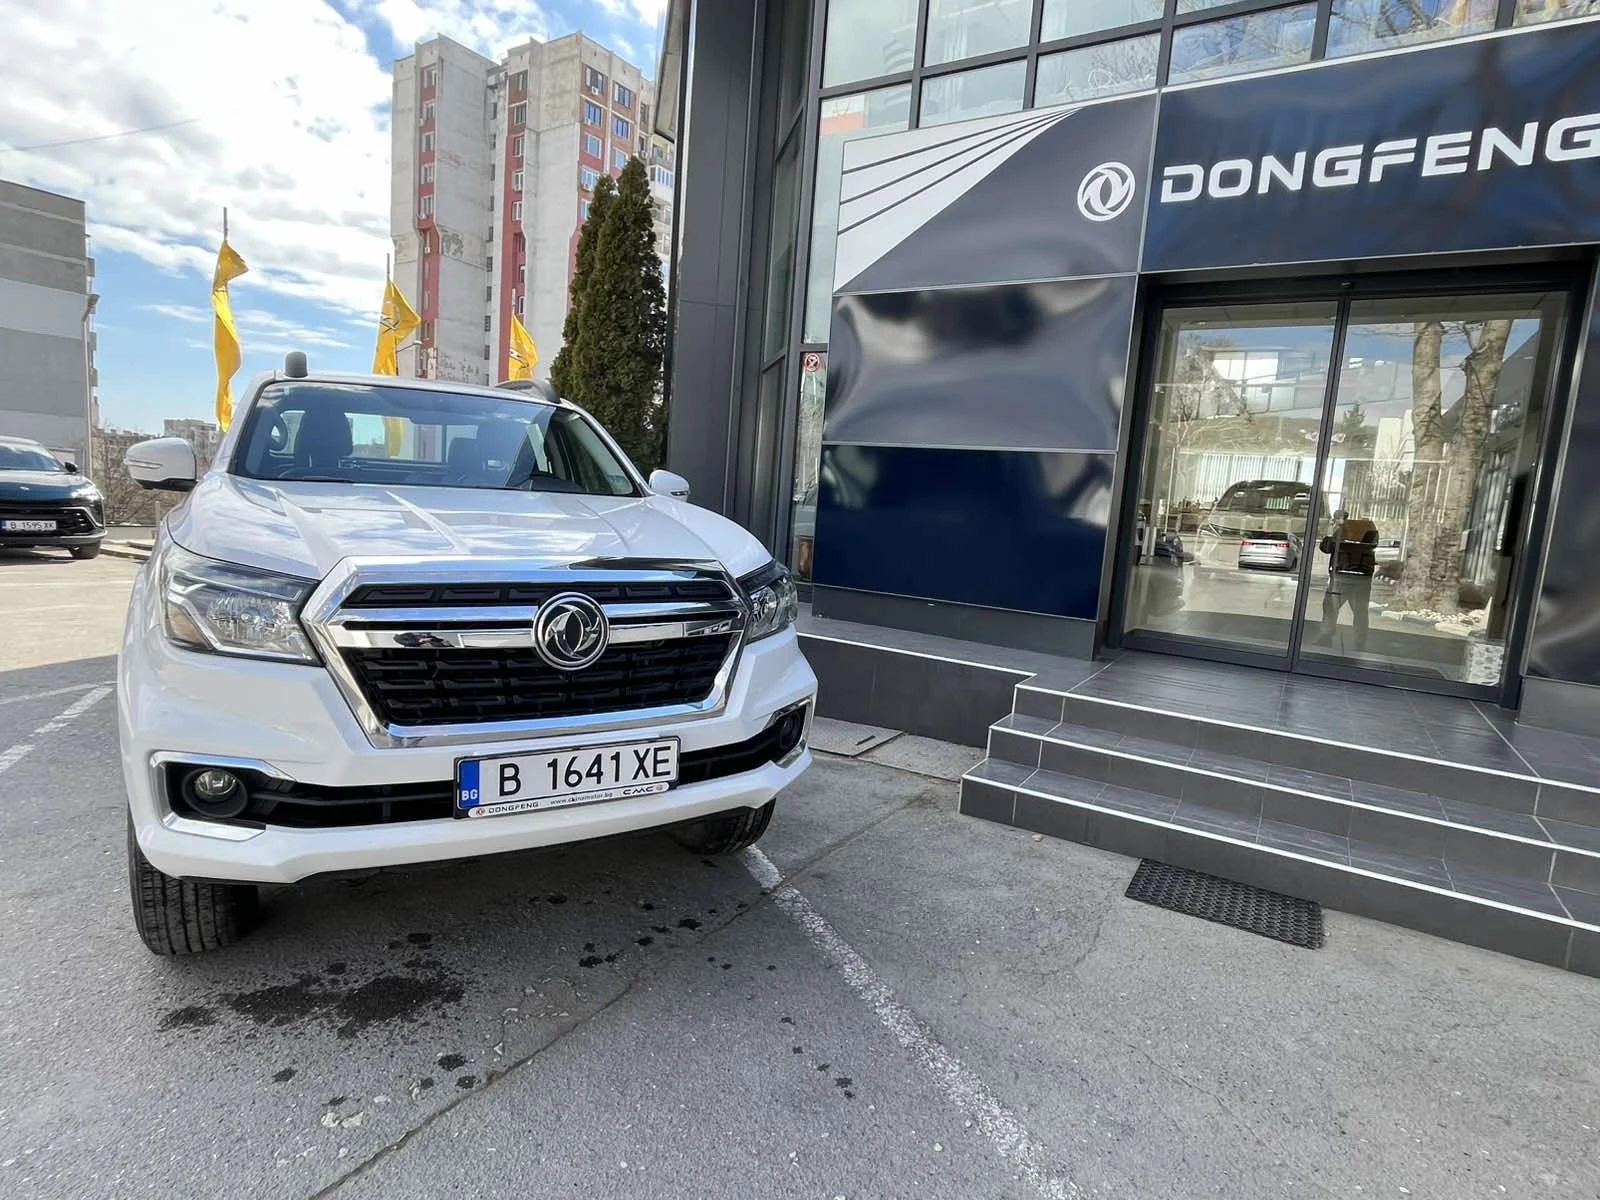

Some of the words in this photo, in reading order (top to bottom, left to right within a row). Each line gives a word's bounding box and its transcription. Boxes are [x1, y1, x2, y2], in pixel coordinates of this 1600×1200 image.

[1161, 113, 1600, 203] DONGFENG
[499, 763, 522, 796] B
[547, 751, 620, 790] 1641
[632, 745, 672, 780] XE
[461, 788, 479, 801] BG
[488, 801, 539, 814] DONGFENG
[623, 786, 654, 796] CMC
